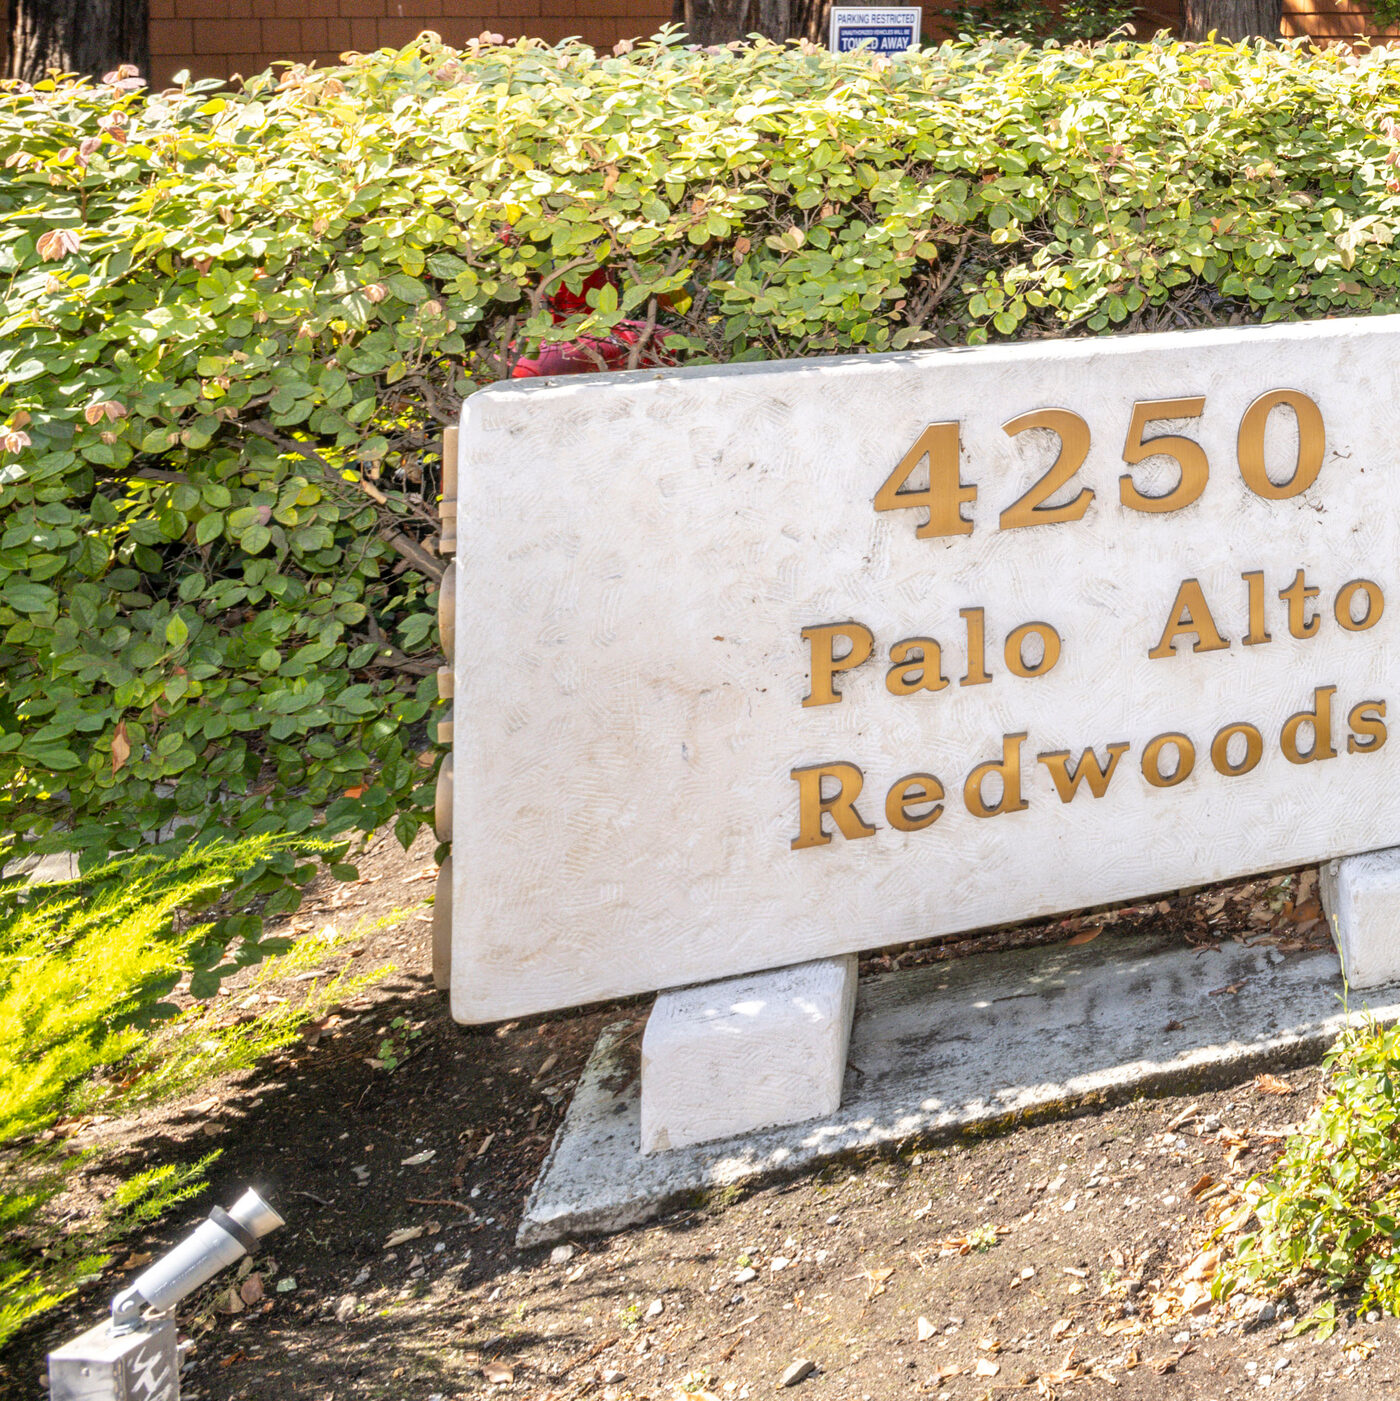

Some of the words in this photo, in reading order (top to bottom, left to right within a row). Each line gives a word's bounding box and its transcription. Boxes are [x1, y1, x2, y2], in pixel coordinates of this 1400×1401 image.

[837, 13, 869, 24] PARKING
[871, 13, 915, 24] RESTRICTED
[880, 37, 909, 50] AWAY
[875, 389, 1326, 538] 4250
[801, 608, 1061, 707] Palo
[1148, 570, 1385, 658] Alto
[791, 686, 1387, 849] Redwoods
